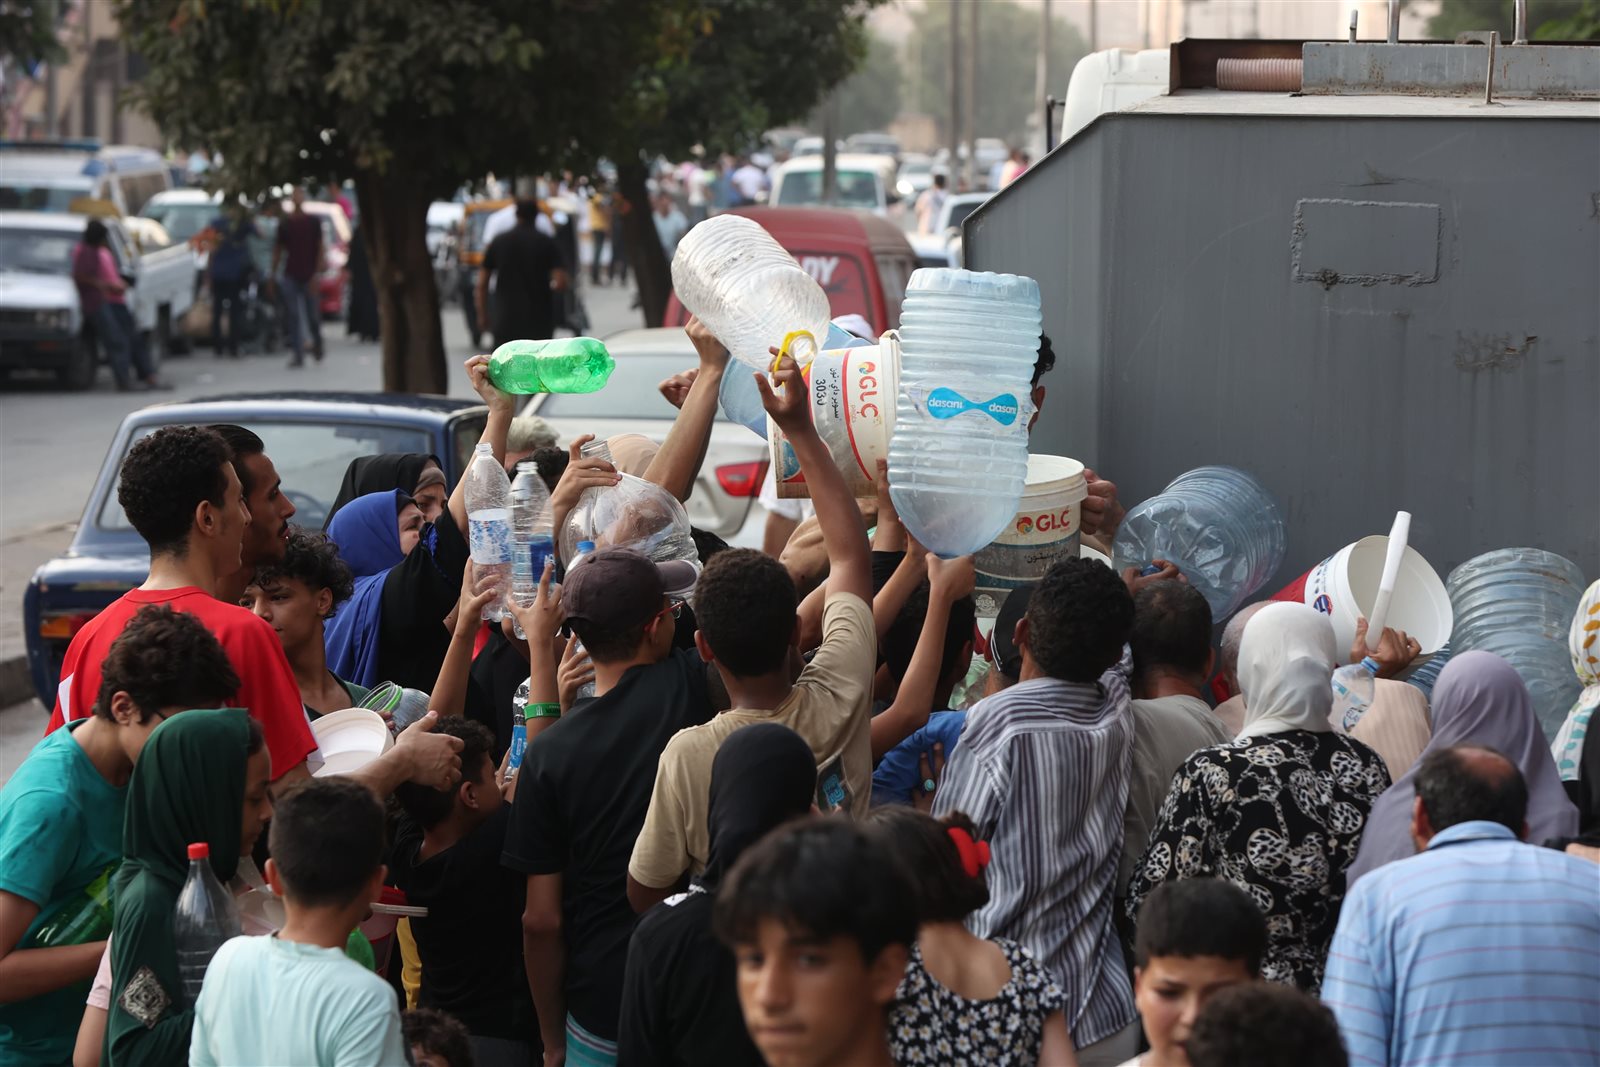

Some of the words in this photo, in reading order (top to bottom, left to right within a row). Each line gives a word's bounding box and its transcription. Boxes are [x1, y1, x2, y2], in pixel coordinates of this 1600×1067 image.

[858, 375, 879, 418] GLC
[928, 397, 963, 409] dasani
[1035, 509, 1070, 532] GLC
